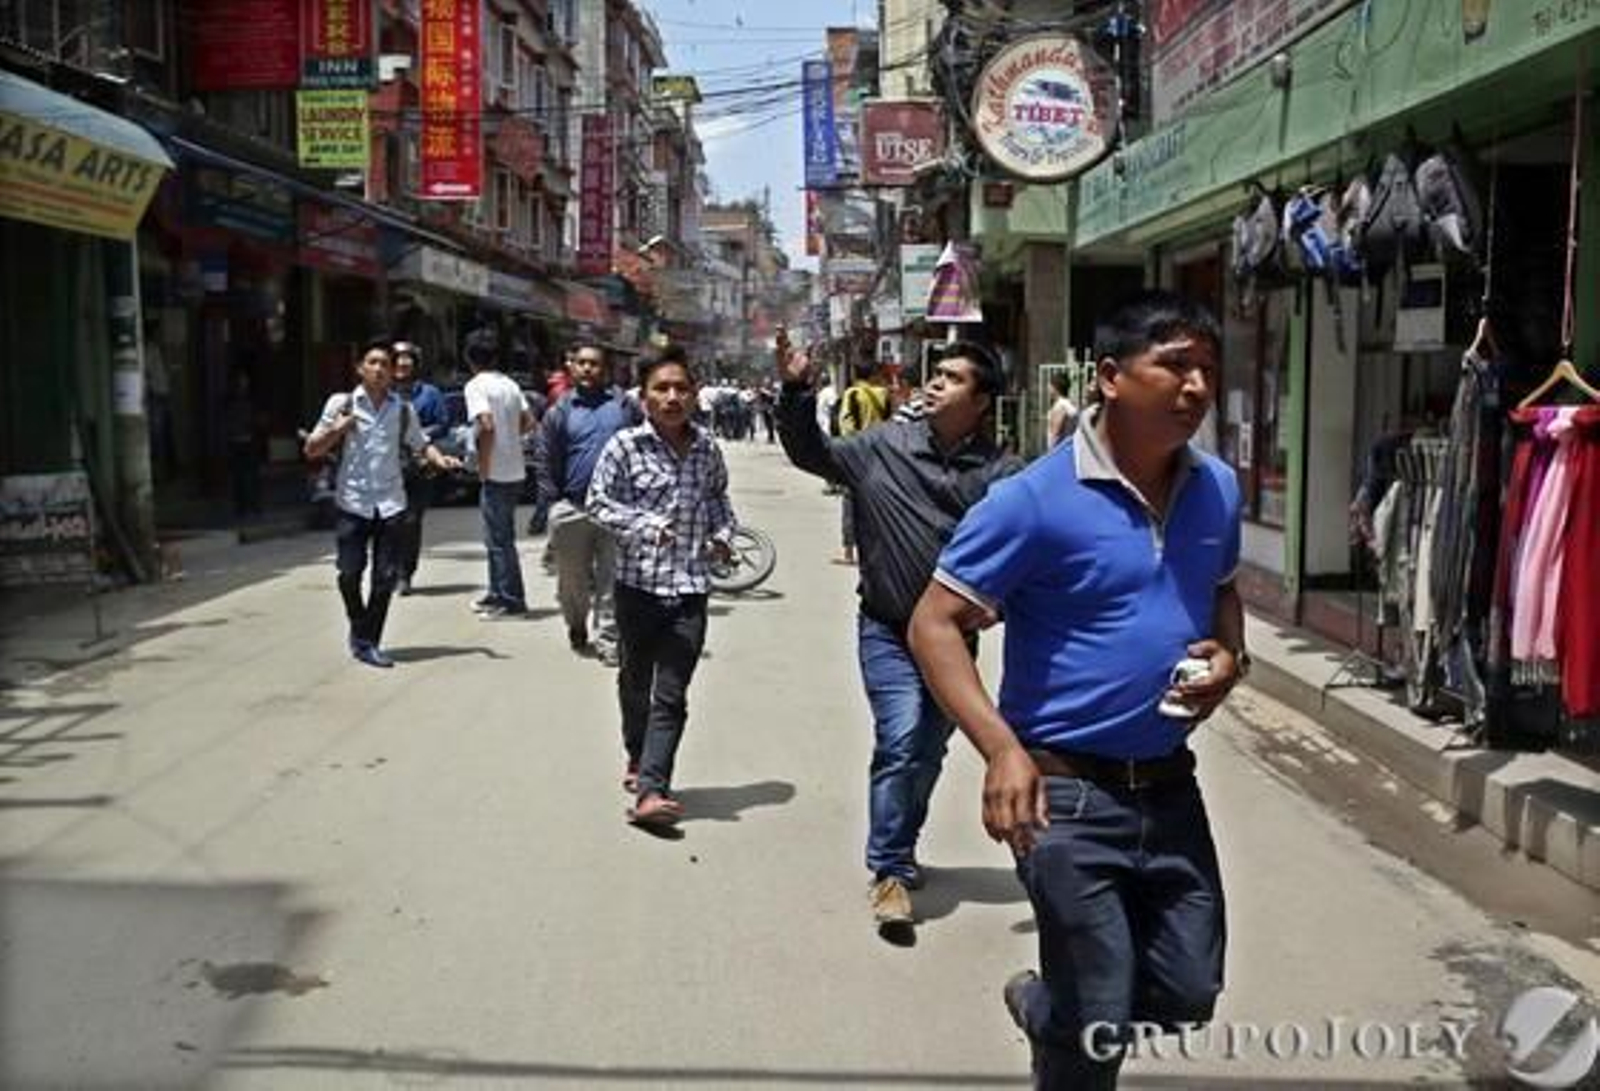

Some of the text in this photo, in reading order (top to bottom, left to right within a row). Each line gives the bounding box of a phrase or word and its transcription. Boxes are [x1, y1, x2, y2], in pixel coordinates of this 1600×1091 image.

[1014, 102, 1086, 125] TIBET
[0, 115, 153, 194] ASA ARTS
